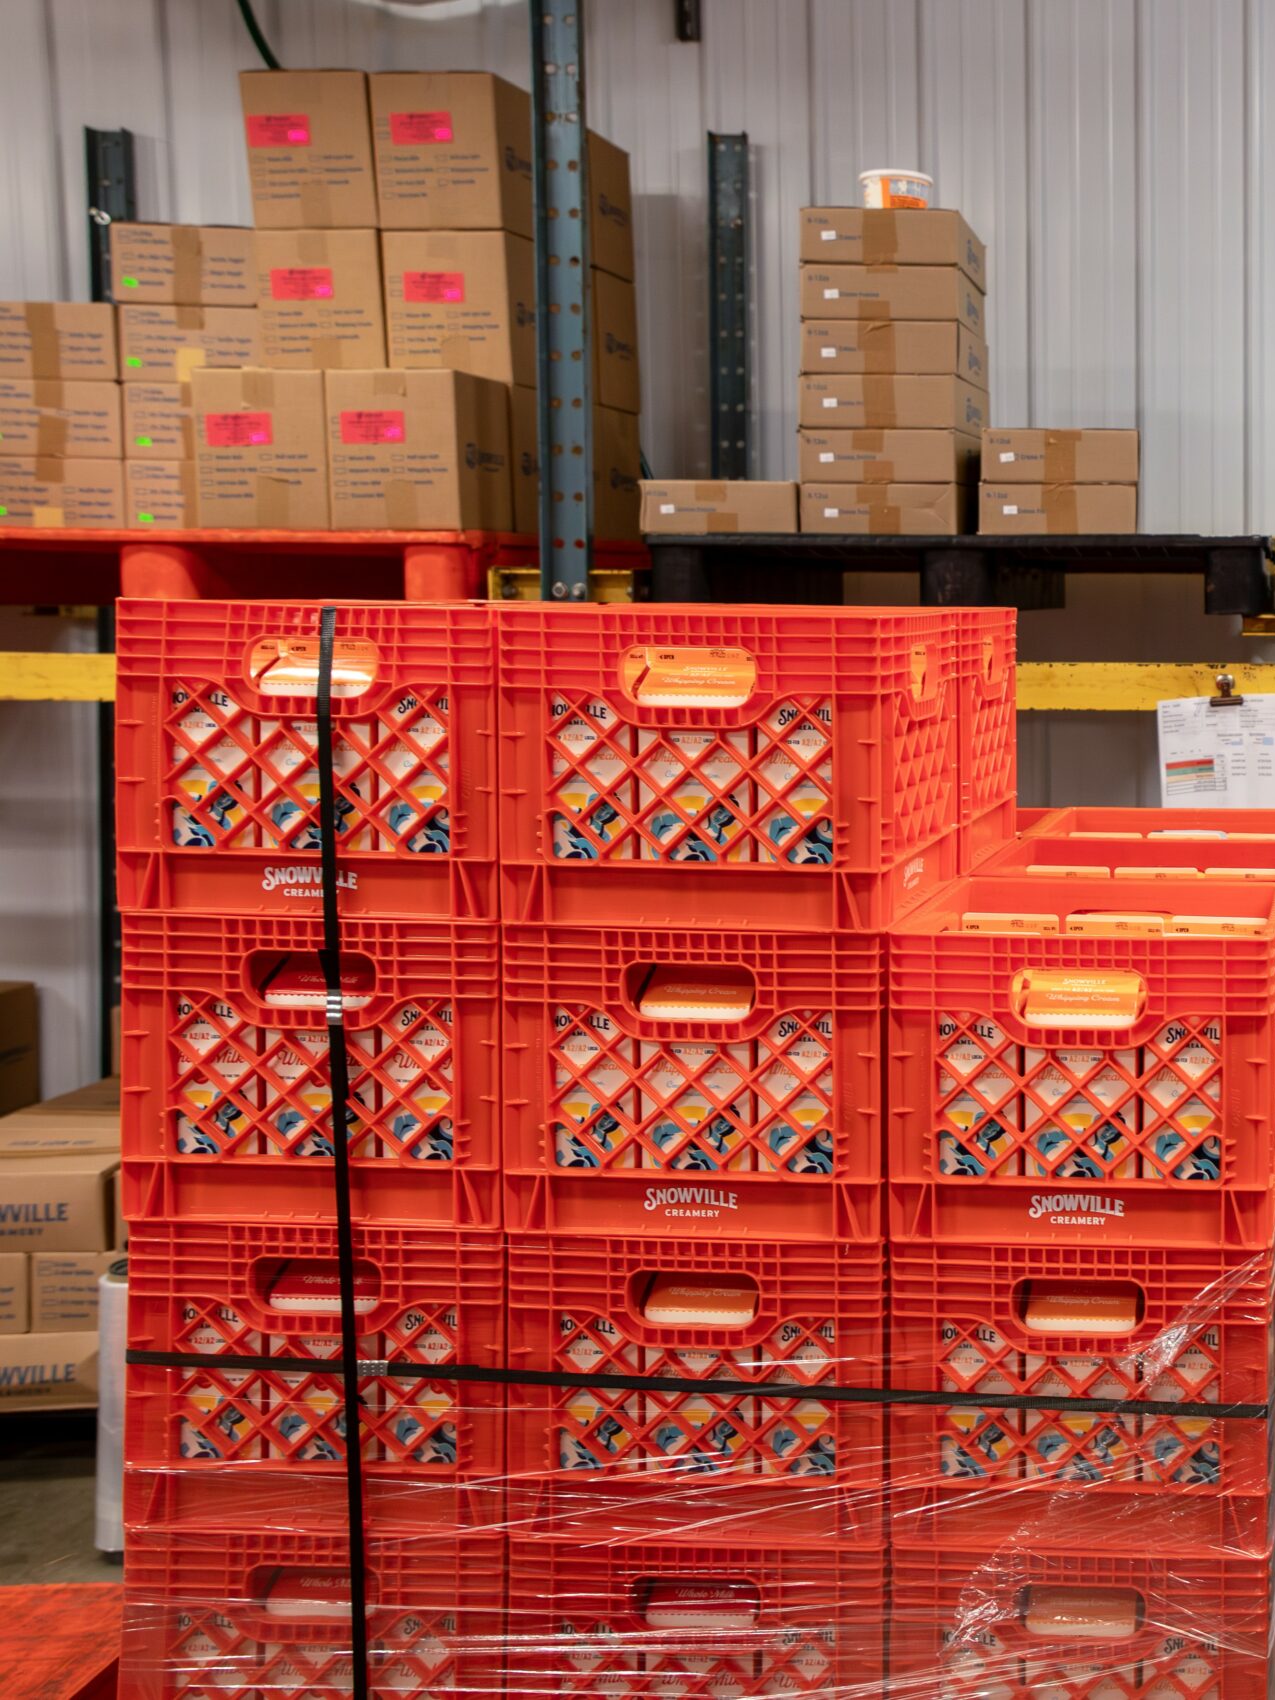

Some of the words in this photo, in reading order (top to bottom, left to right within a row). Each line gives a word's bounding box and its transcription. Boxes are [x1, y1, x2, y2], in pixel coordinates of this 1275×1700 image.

[644, 1188, 738, 1211] SNOWVILLE
[1029, 1194, 1125, 1218] SNOWVILLE
[665, 1209, 720, 1218] CREAMERY
[1050, 1216, 1106, 1225] CREAMERY
